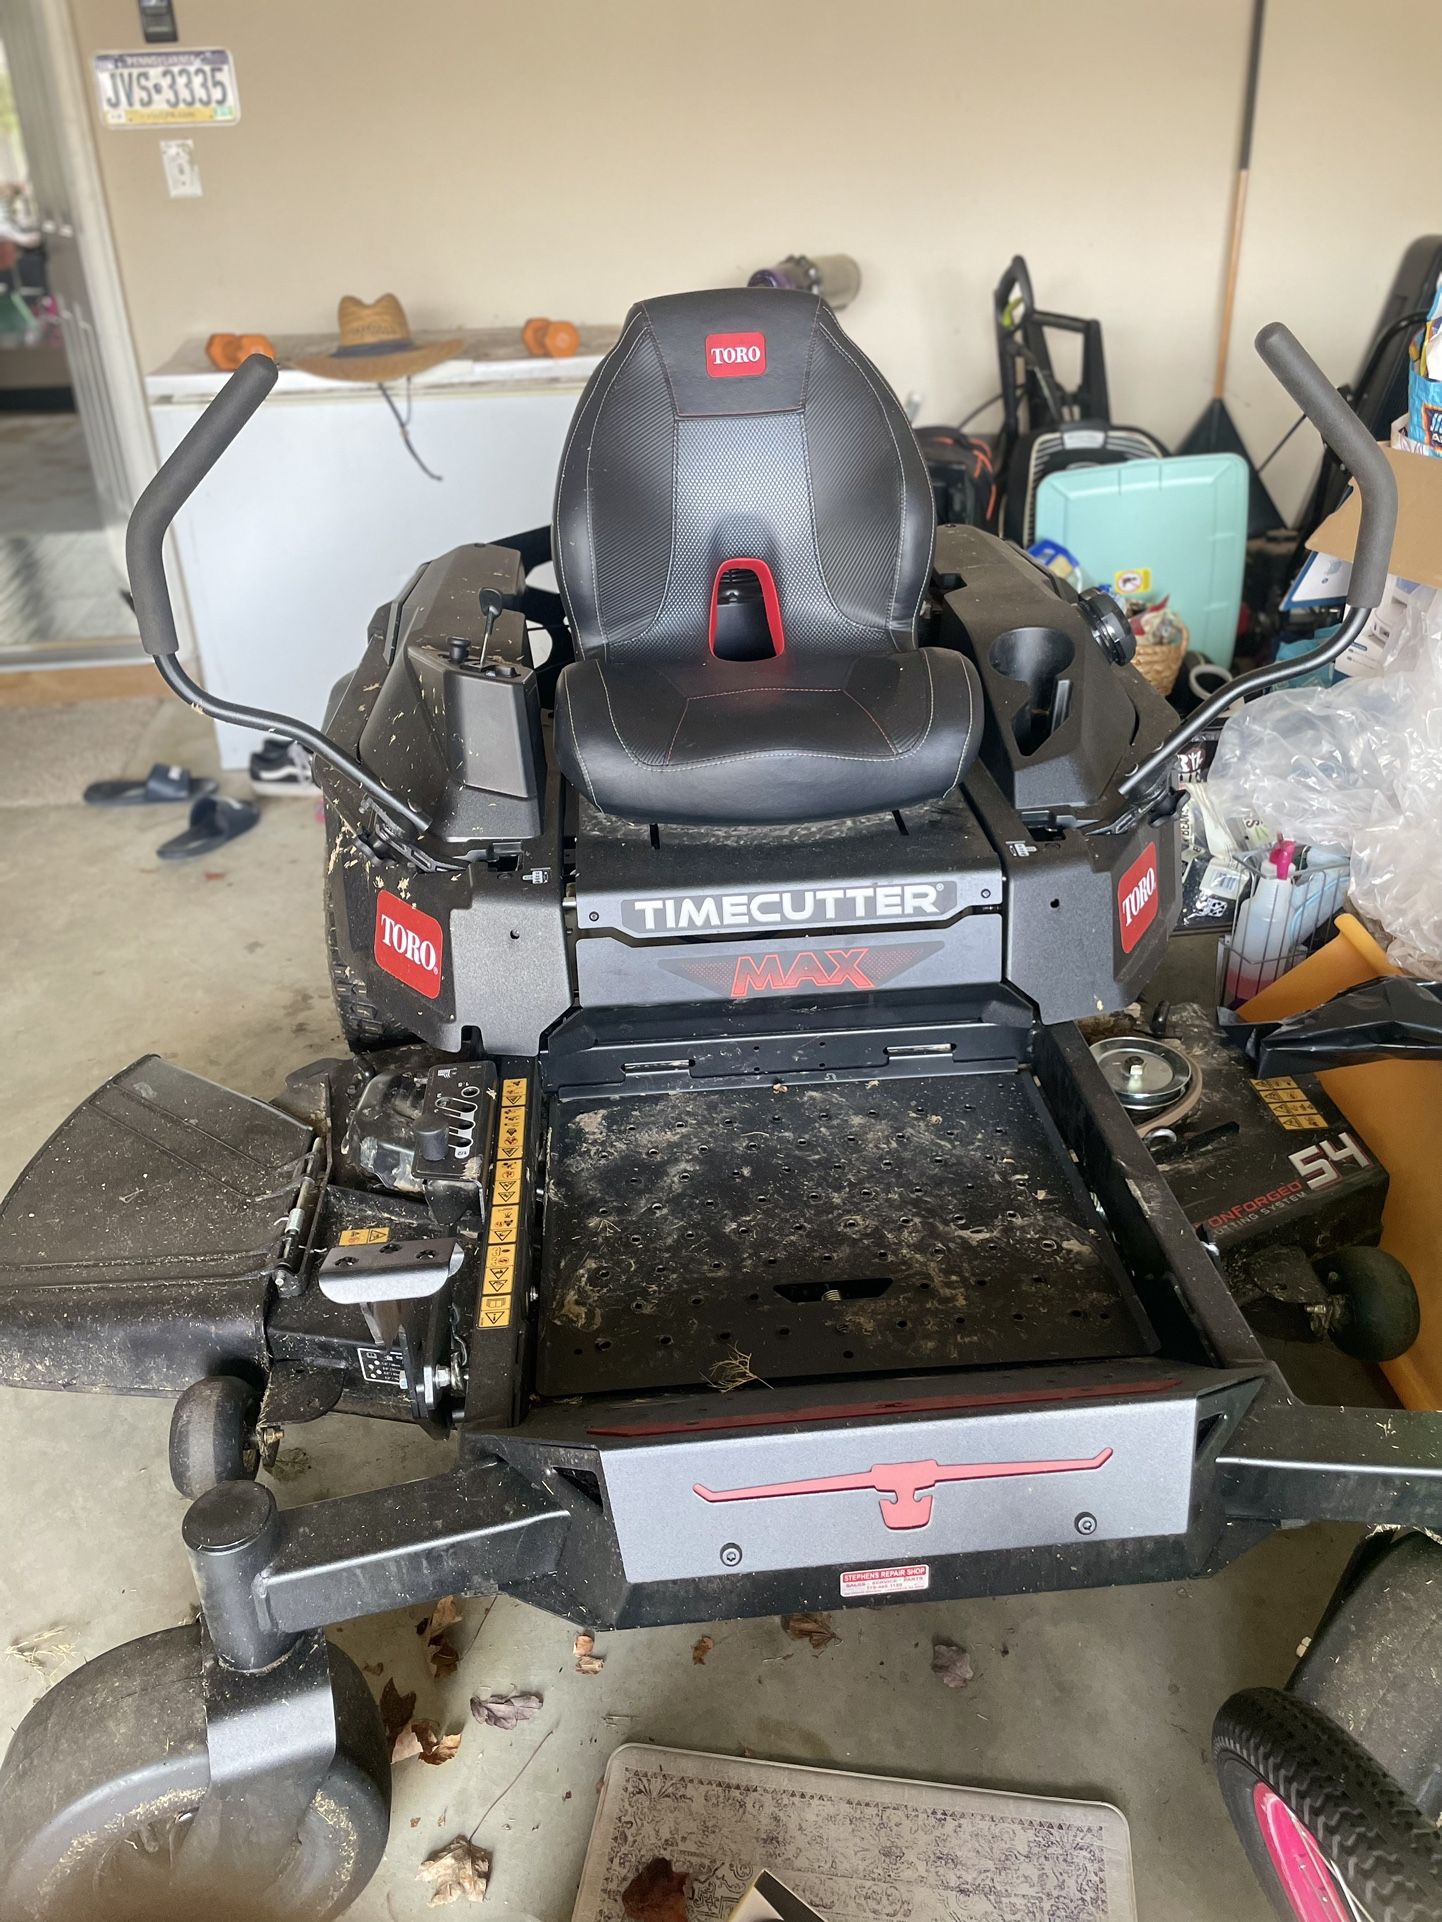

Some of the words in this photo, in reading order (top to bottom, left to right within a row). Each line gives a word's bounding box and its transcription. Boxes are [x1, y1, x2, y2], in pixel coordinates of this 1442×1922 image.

[711, 346, 761, 365] TORO
[1122, 868, 1155, 928] TORO
[381, 914, 436, 971] TORO
[731, 948, 876, 998] MAX
[1288, 1131, 1372, 1190] 54
[1194, 1179, 1303, 1230] ONFORGED
[1214, 1212, 1258, 1236] UTTING
[1260, 1191, 1307, 1216] SYSTEM
[844, 1573, 880, 1582] STEPHENS
[881, 1569, 905, 1578] REPAIR
[906, 1567, 925, 1575] SHOP
